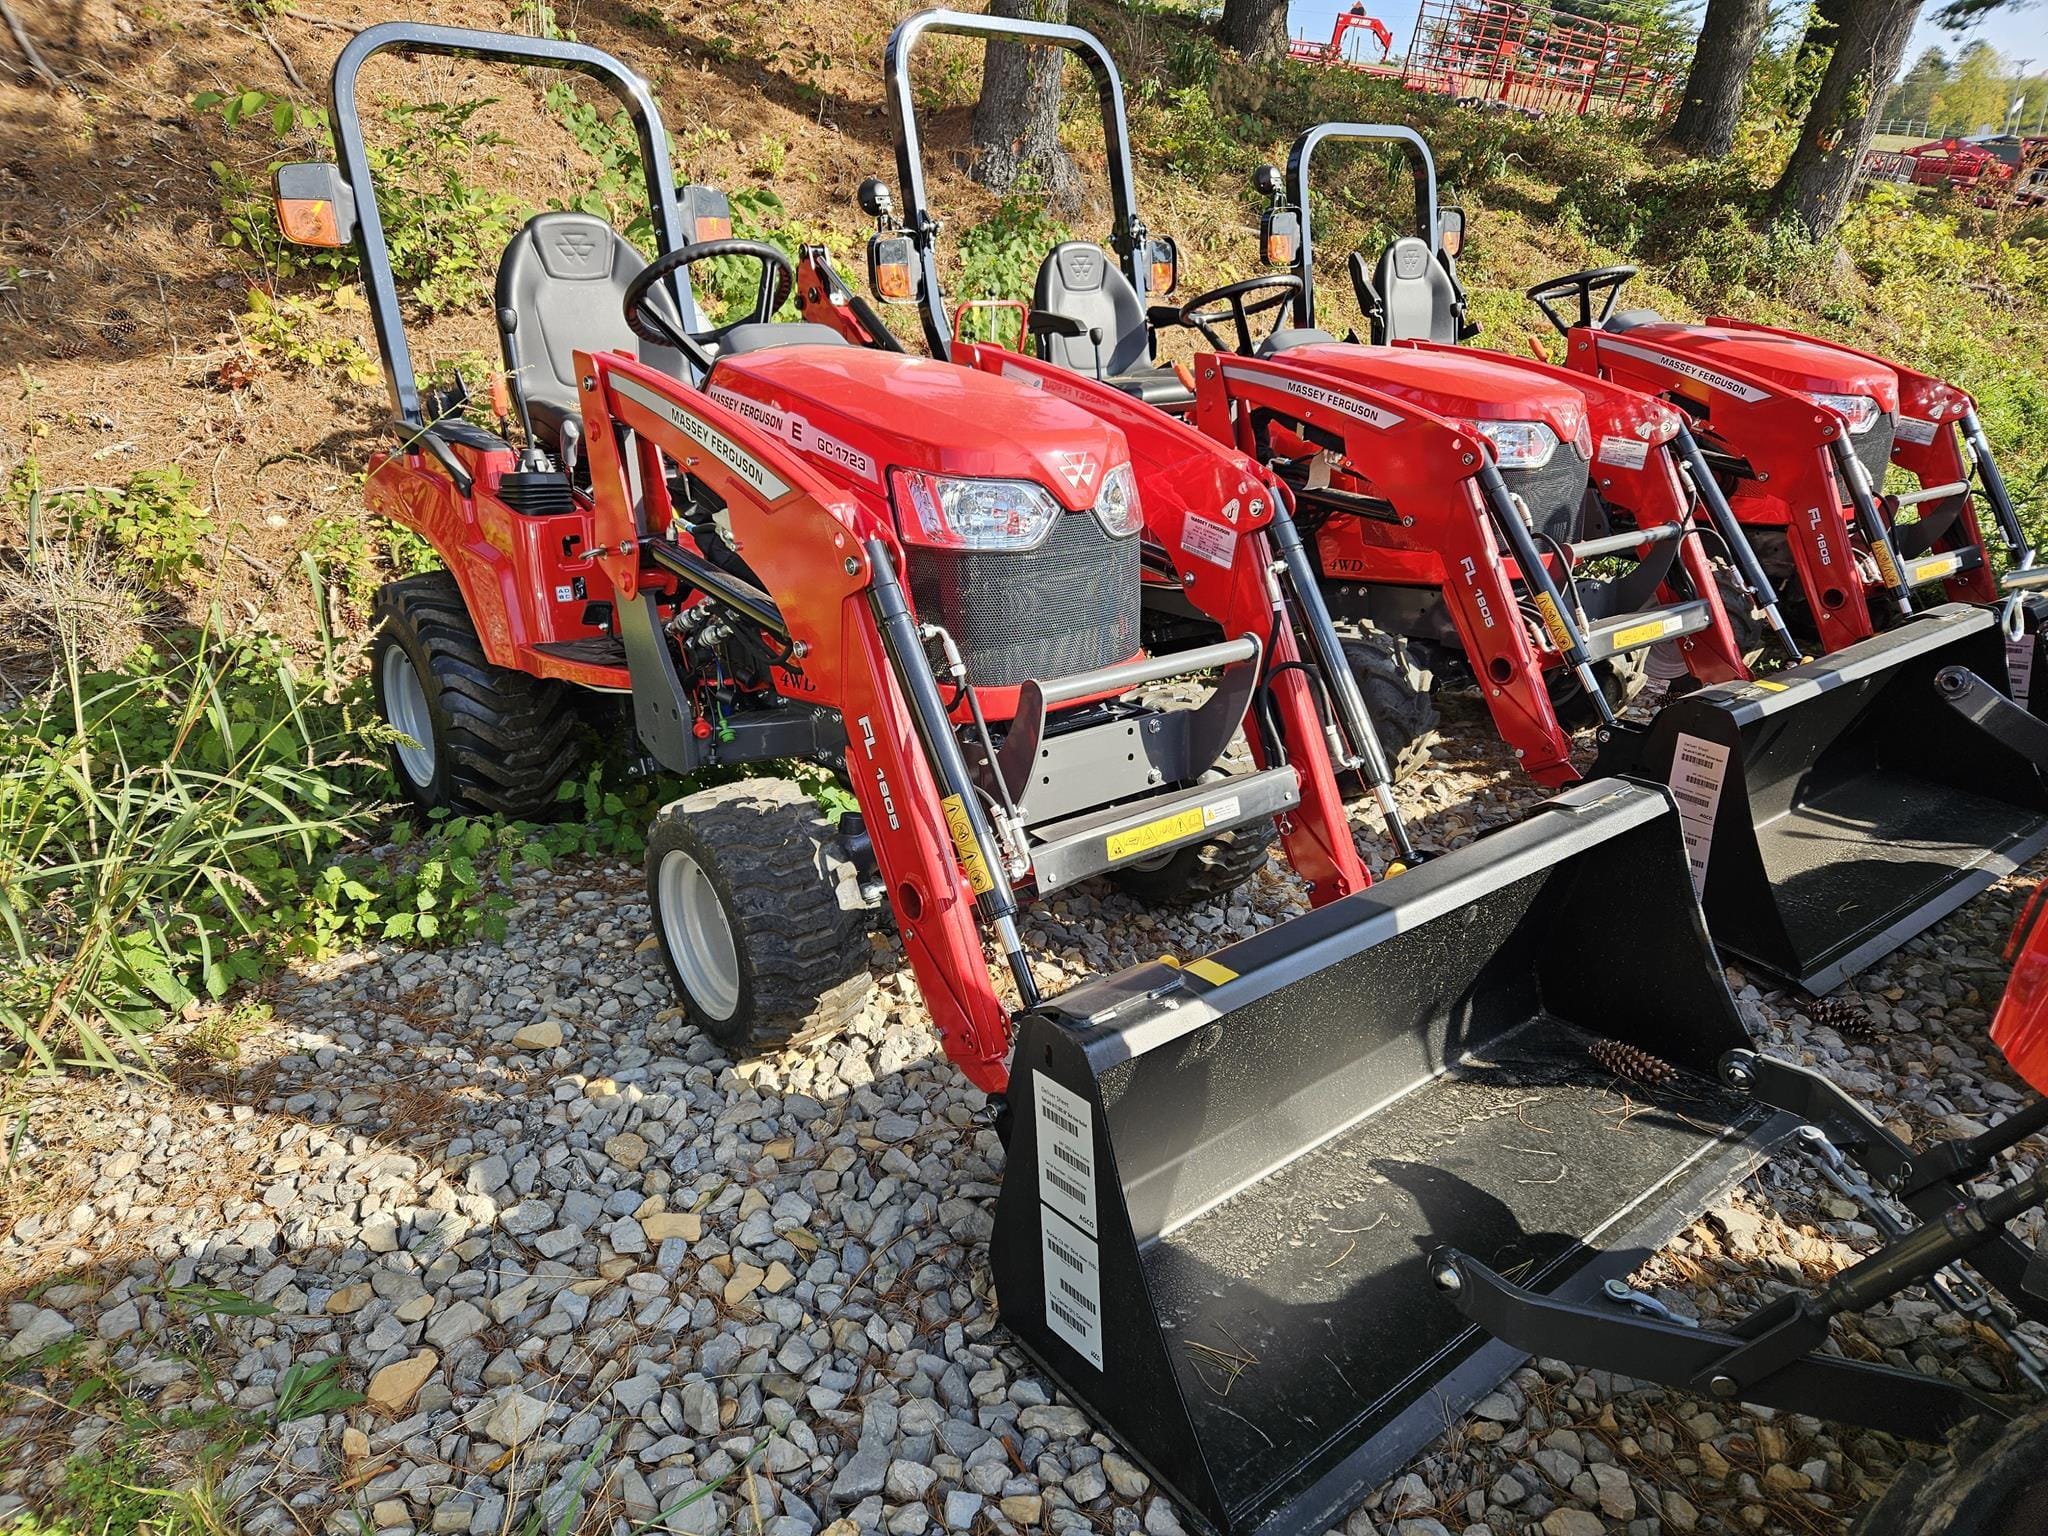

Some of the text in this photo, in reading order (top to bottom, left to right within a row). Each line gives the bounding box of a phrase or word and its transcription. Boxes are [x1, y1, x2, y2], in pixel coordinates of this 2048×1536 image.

[1287, 382, 1378, 421] MASSEY FERGUSON
[1660, 357, 1747, 396] MASSEY FERGUSON
[671, 407, 764, 486] MASSEY FERGUSON
[710, 391, 866, 471] MASSEY FERGUSON E GC 1723
[1329, 559, 1363, 572] 4WD
[1807, 507, 1832, 566] FL 1805
[1460, 556, 1495, 629] FL 1805
[857, 715, 900, 831] FL 1805
[1079, 1214, 1094, 1229] AGCO
